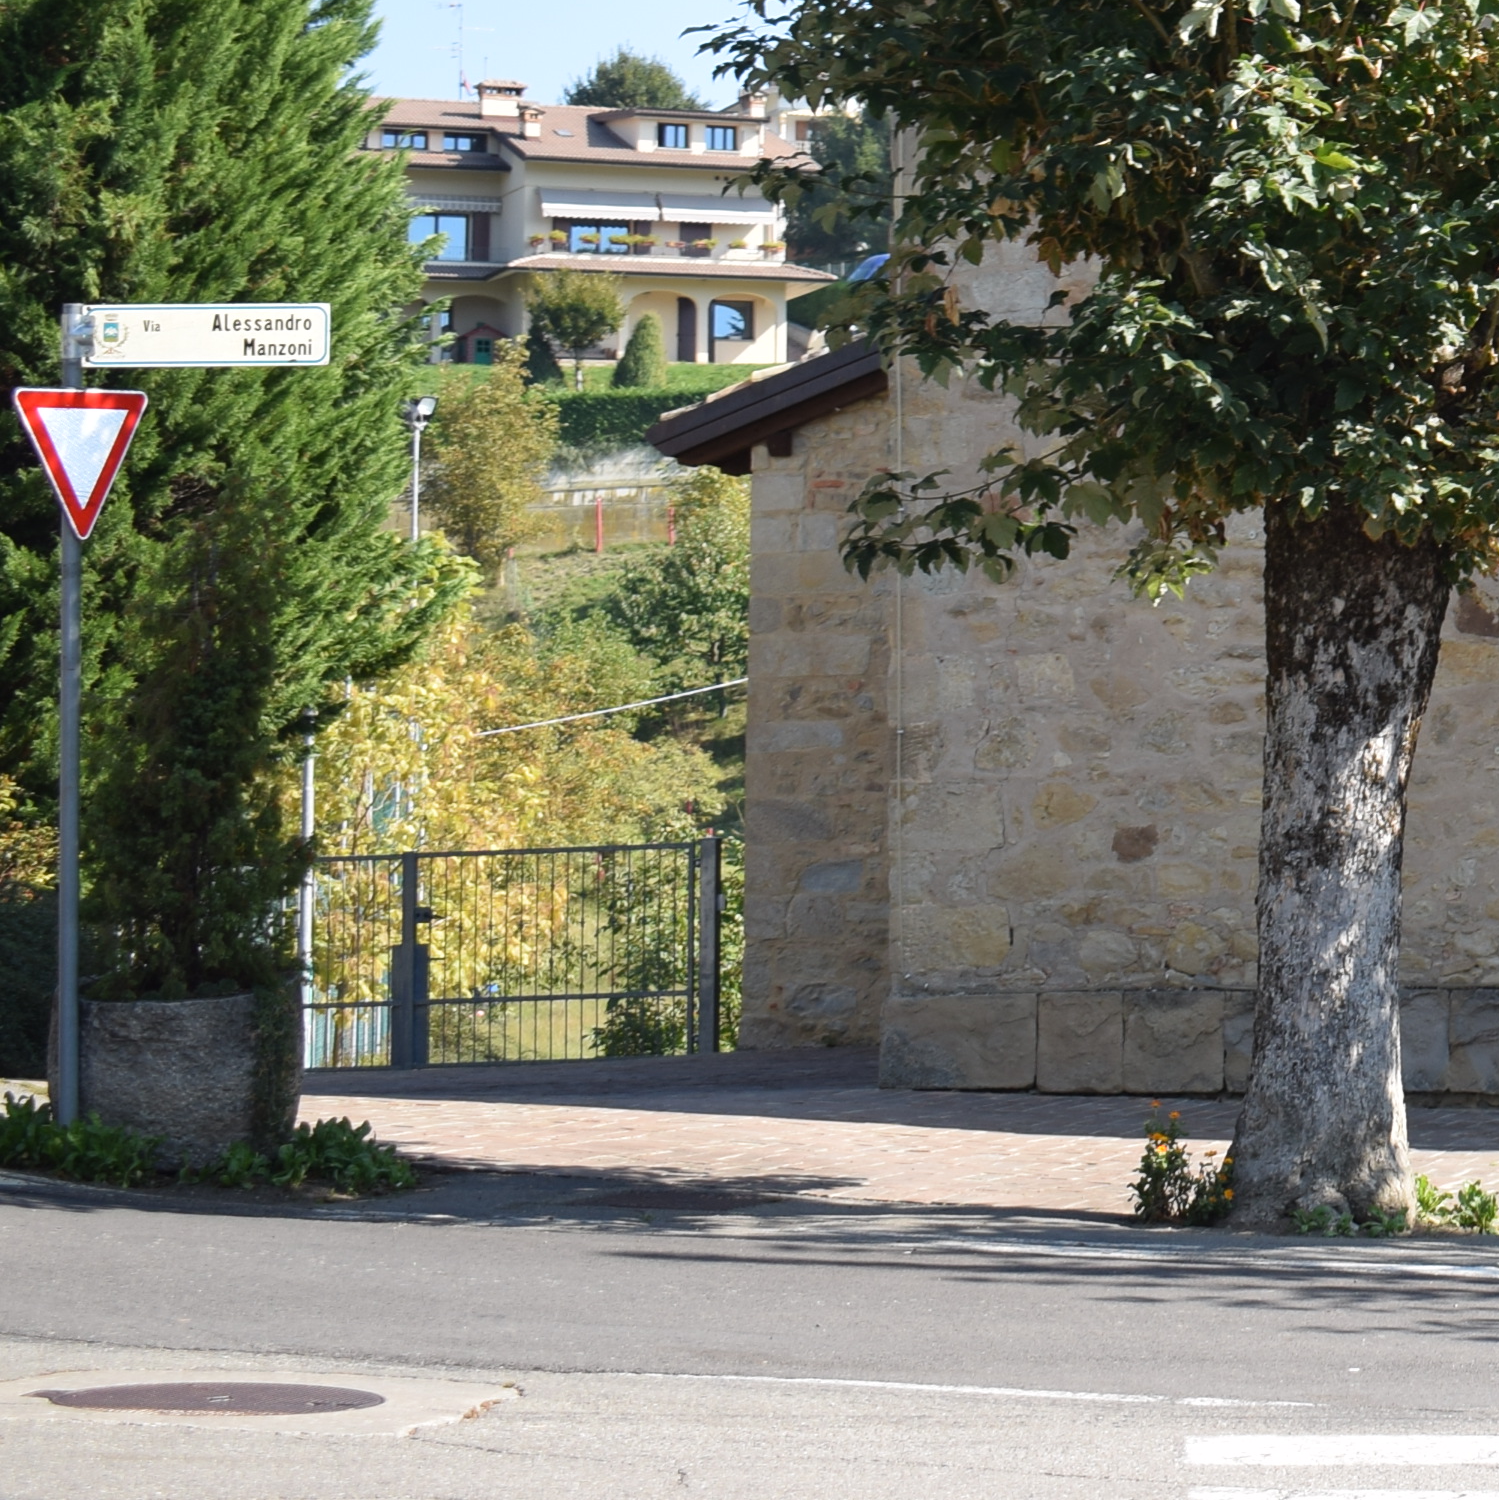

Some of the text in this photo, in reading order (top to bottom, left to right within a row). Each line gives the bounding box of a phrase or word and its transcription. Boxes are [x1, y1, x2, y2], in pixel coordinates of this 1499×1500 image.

[143, 313, 312, 332] Via Alessandro
[243, 338, 312, 356] Manzoni
